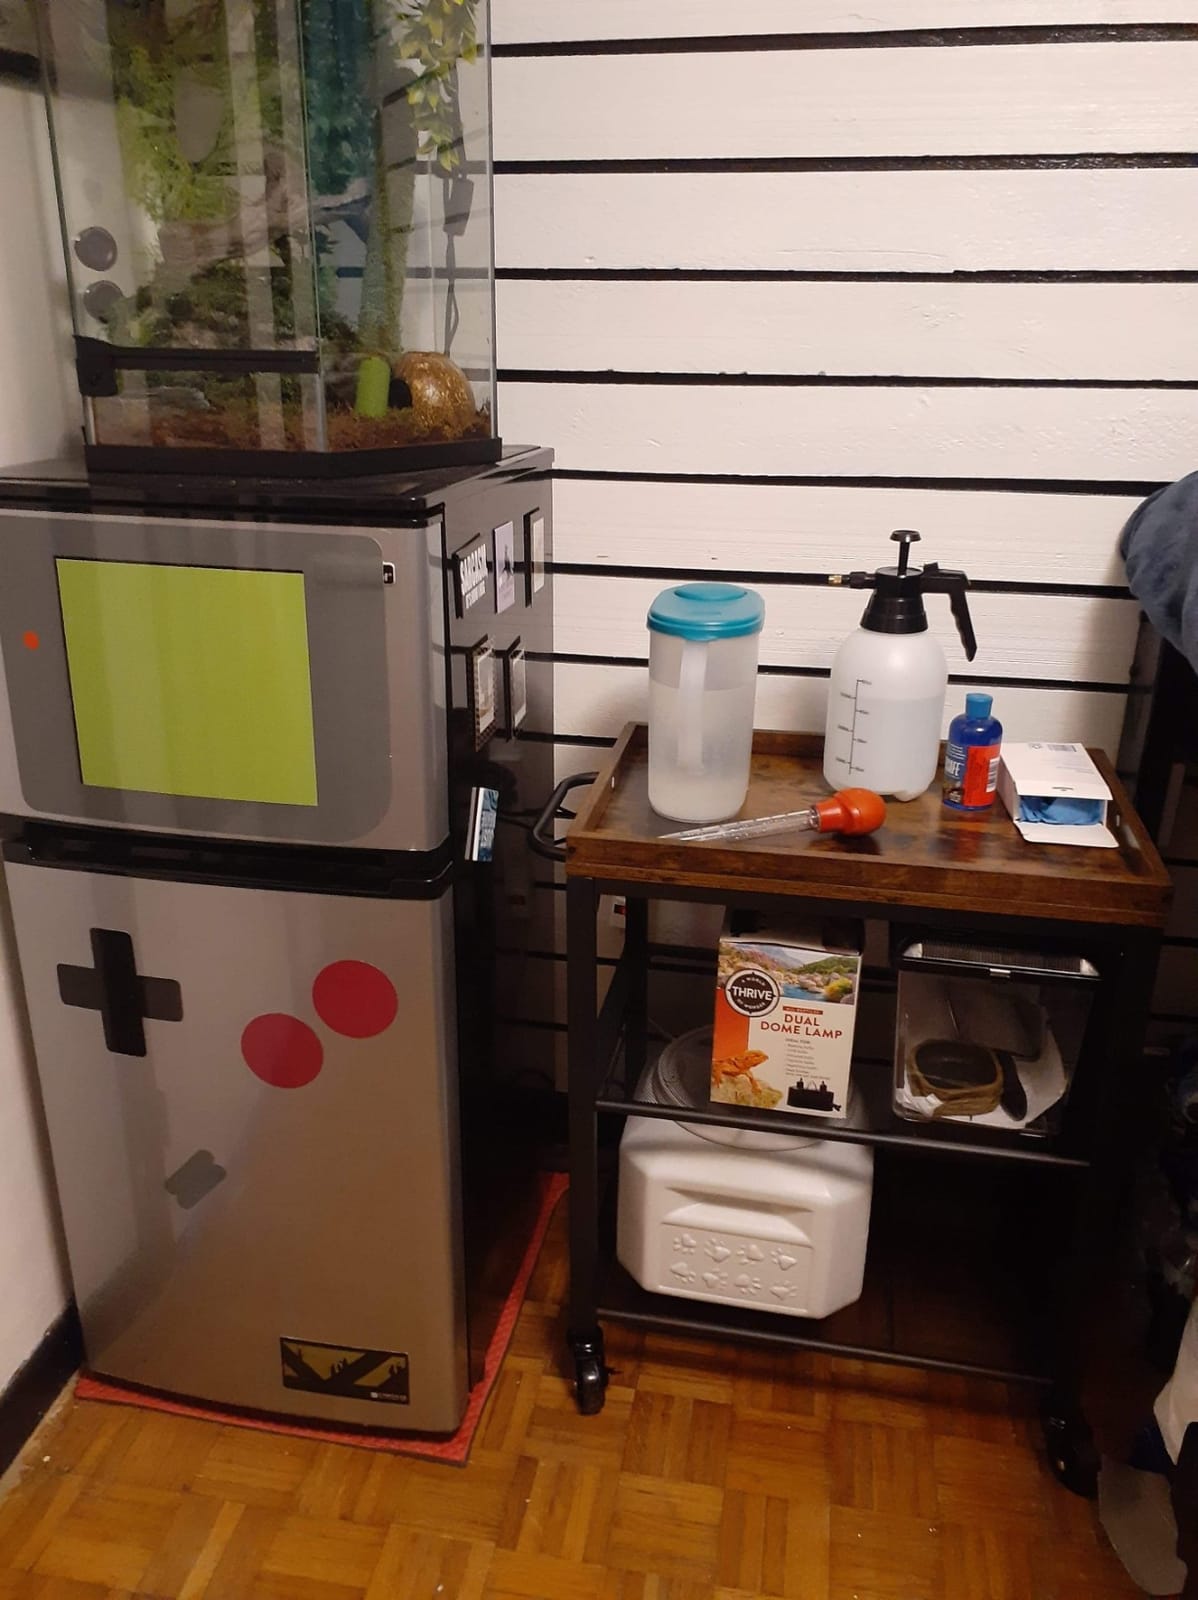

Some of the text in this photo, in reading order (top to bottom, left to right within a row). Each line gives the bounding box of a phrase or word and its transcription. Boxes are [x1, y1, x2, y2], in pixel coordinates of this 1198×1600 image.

[732, 986, 773, 1001] THRIVE
[784, 1013, 820, 1027] DUAL
[760, 1020, 843, 1039] DOME LAMP
